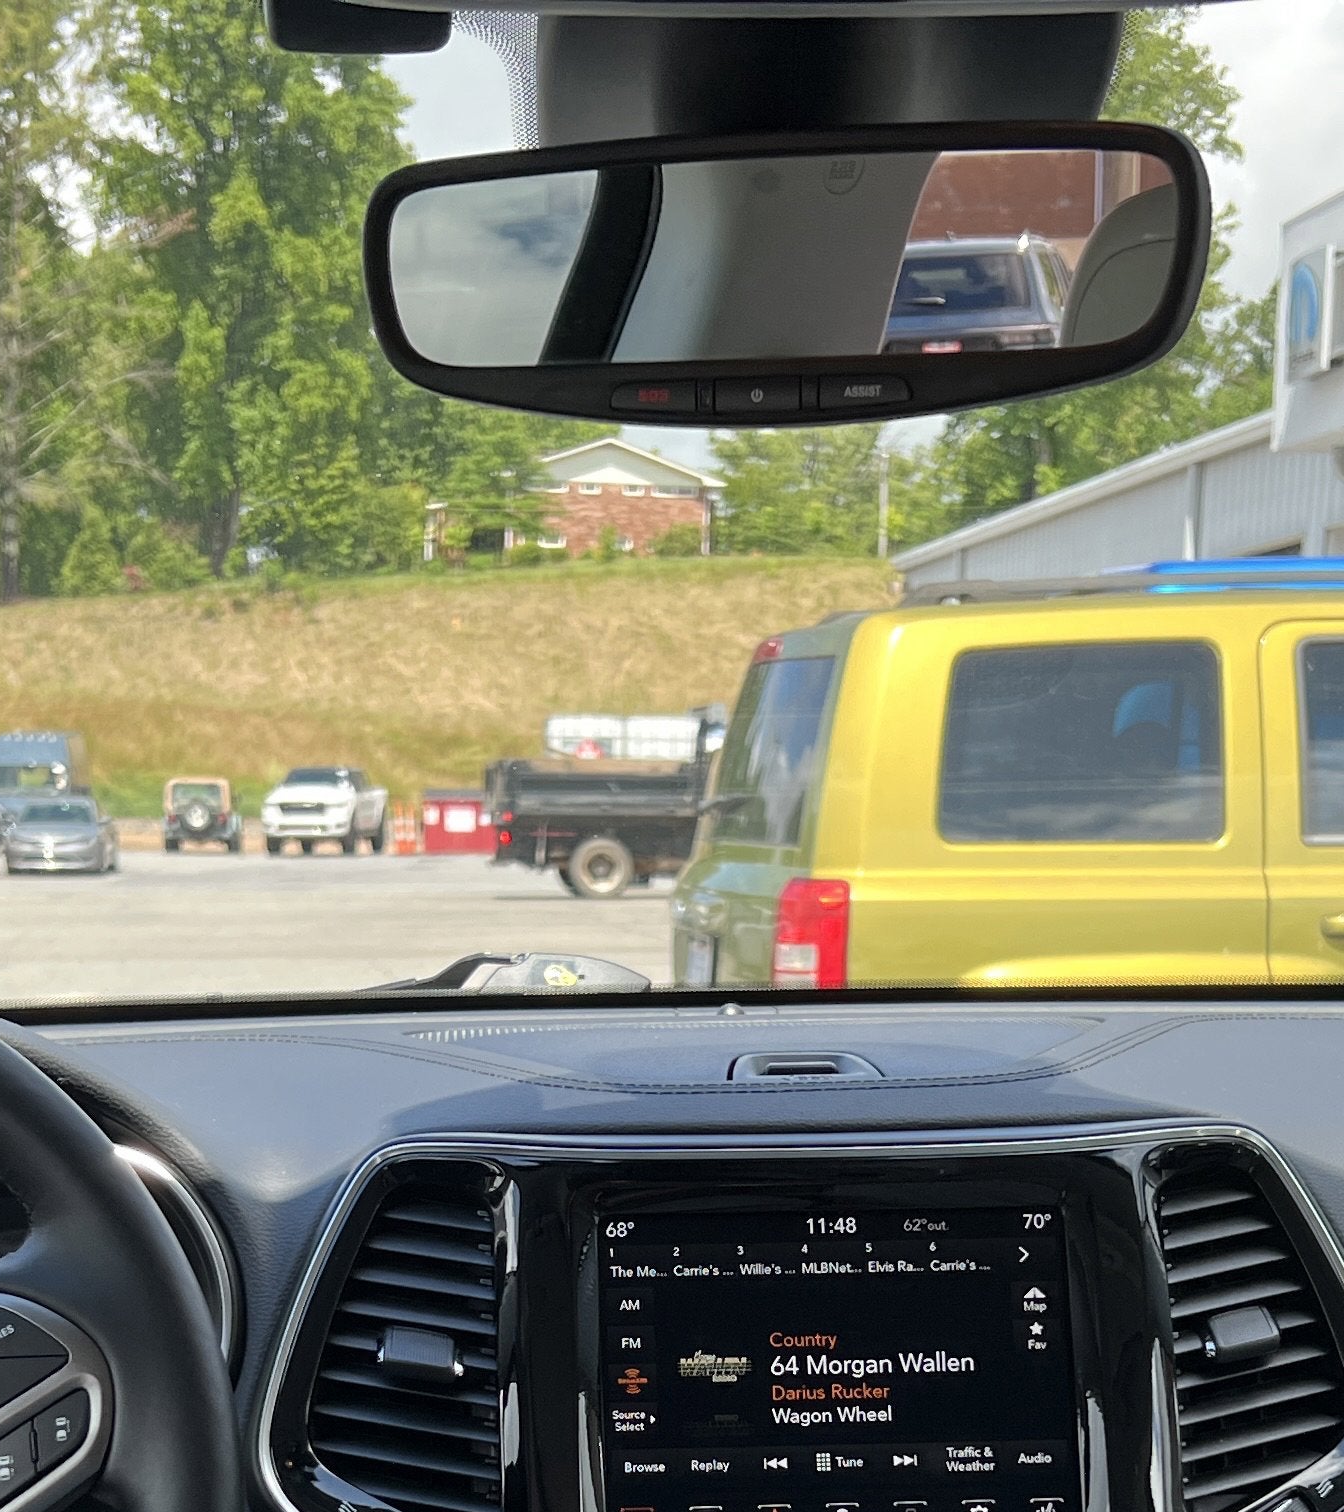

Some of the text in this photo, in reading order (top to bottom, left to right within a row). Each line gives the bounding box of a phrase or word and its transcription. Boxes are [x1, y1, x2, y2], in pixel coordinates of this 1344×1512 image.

[844, 384, 882, 397] ASSIST
[806, 1217, 857, 1234] 11:48
[673, 1247, 679, 1256] 2
[737, 1246, 744, 1255] 3
[801, 1244, 808, 1253] 4
[865, 1243, 872, 1252] 5
[929, 1242, 937, 1251] 6
[609, 1248, 613, 1257] 1
[673, 1265, 720, 1277] Carrie's
[740, 1263, 782, 1275] Willie's
[868, 1261, 894, 1273] Elvis
[930, 1260, 976, 1272] Carrie's
[609, 1266, 634, 1278] The
[620, 1300, 640, 1311] AM
[1024, 1301, 1047, 1312] Map
[621, 1338, 641, 1349] FM
[770, 1332, 837, 1349] Country
[1028, 1340, 1047, 1350] Fav
[770, 1355, 799, 1376] 64
[806, 1355, 893, 1378] Morgan
[899, 1351, 975, 1373] Wallen
[772, 1383, 891, 1401] Darius Rucker
[612, 1410, 646, 1420] Source
[772, 1405, 892, 1426] Wagon Wheel
[615, 1422, 645, 1432] Select
[946, 1447, 994, 1458] Traffic &
[835, 1457, 864, 1468] Tune
[1018, 1453, 1052, 1464] Audio
[624, 1462, 666, 1473] Browse
[691, 1459, 730, 1472] Replay
[946, 1460, 995, 1472] Weather
